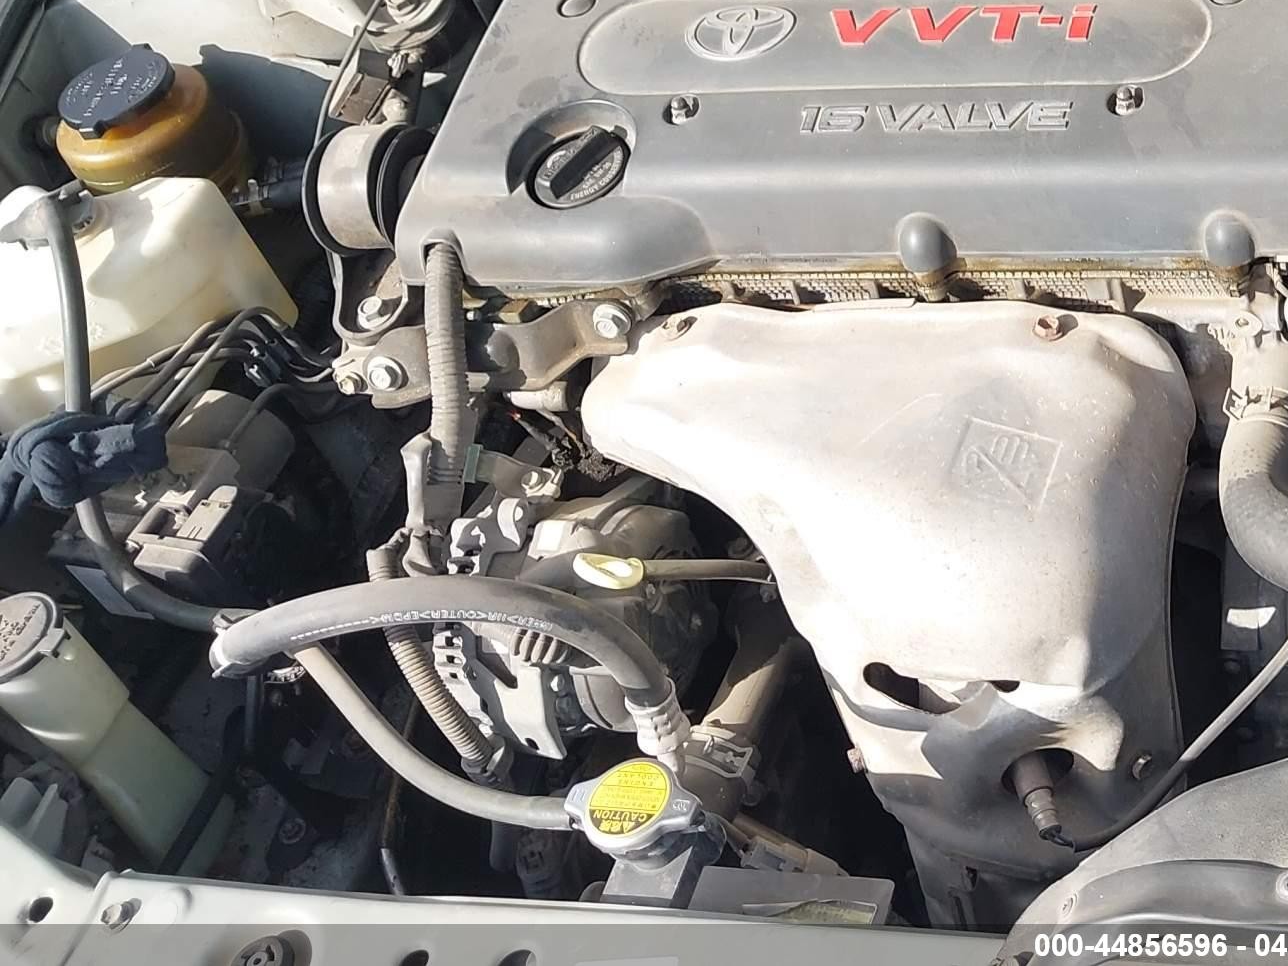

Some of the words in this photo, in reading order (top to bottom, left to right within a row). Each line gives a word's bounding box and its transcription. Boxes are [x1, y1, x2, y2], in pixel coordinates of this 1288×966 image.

[830, 4, 1098, 46] VVT-i
[875, 100, 1075, 132] VALVE
[593, 810, 647, 822] CAUTION
